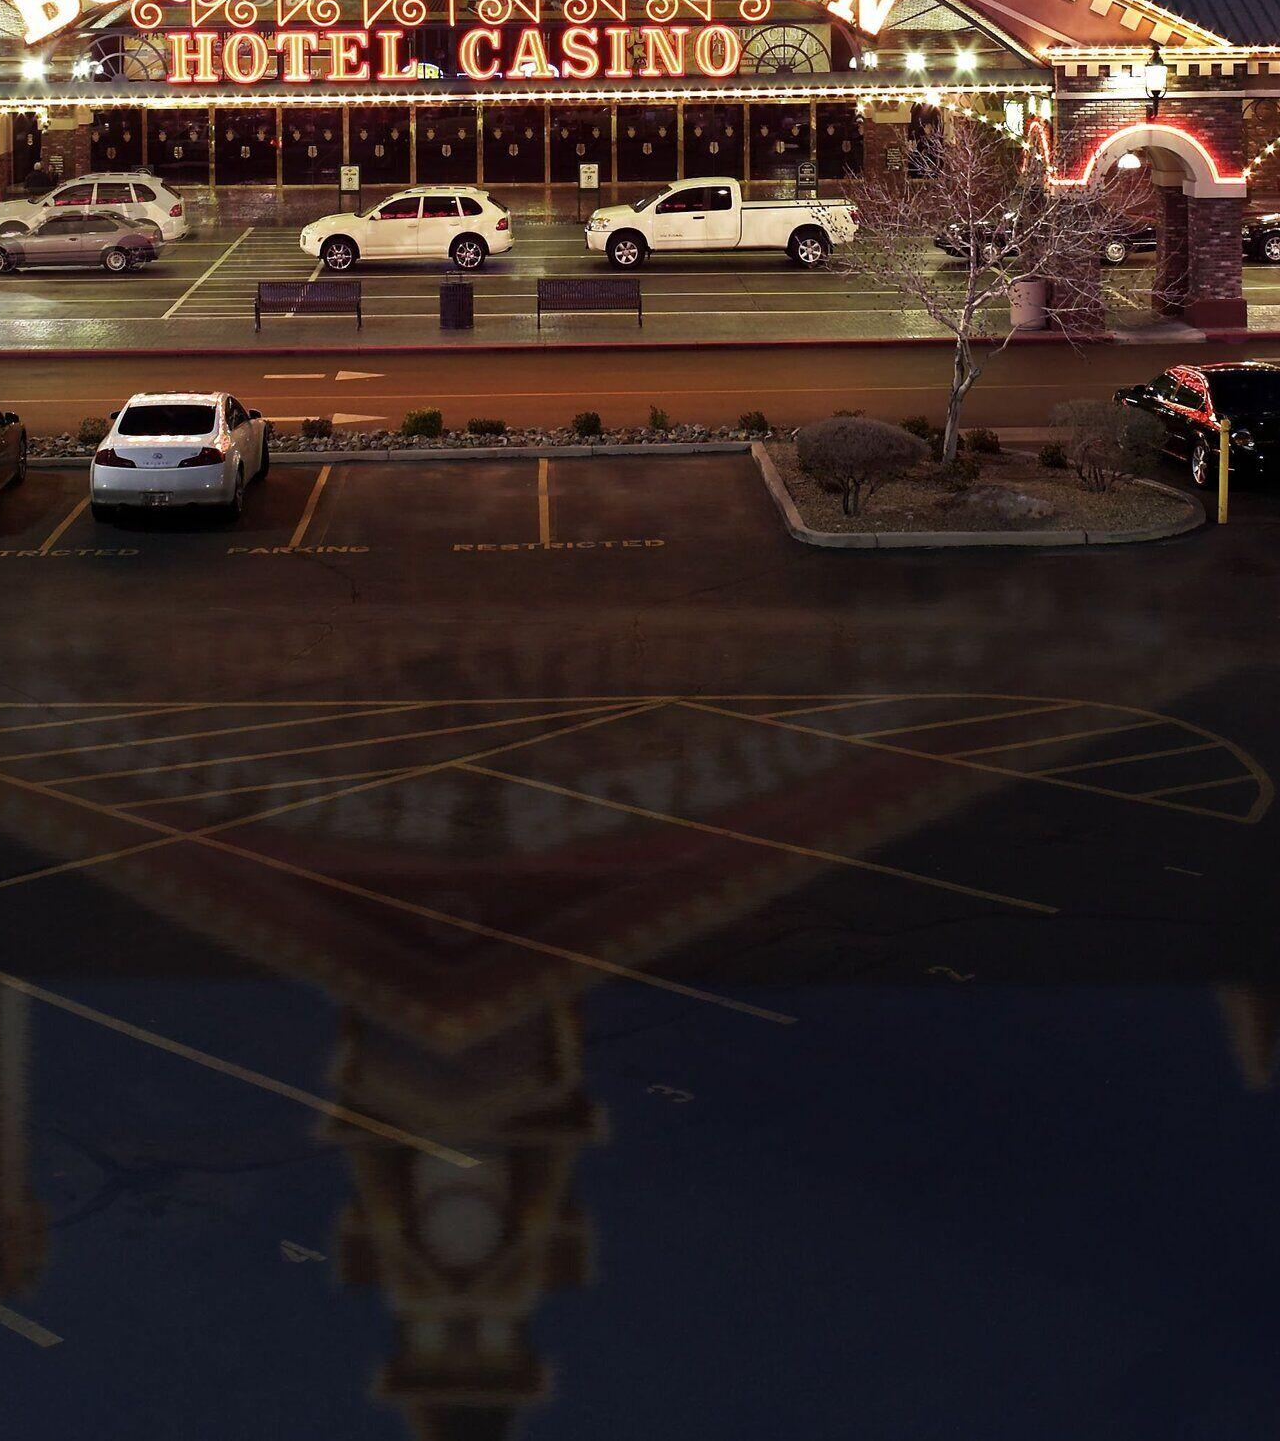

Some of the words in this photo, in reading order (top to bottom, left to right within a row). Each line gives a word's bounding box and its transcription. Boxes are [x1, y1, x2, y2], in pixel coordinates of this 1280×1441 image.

[167, 29, 419, 84] HOTEL
[459, 24, 743, 81] CASINO
[227, 545, 370, 556] PARKING
[451, 538, 666, 551] RESTRICTED
